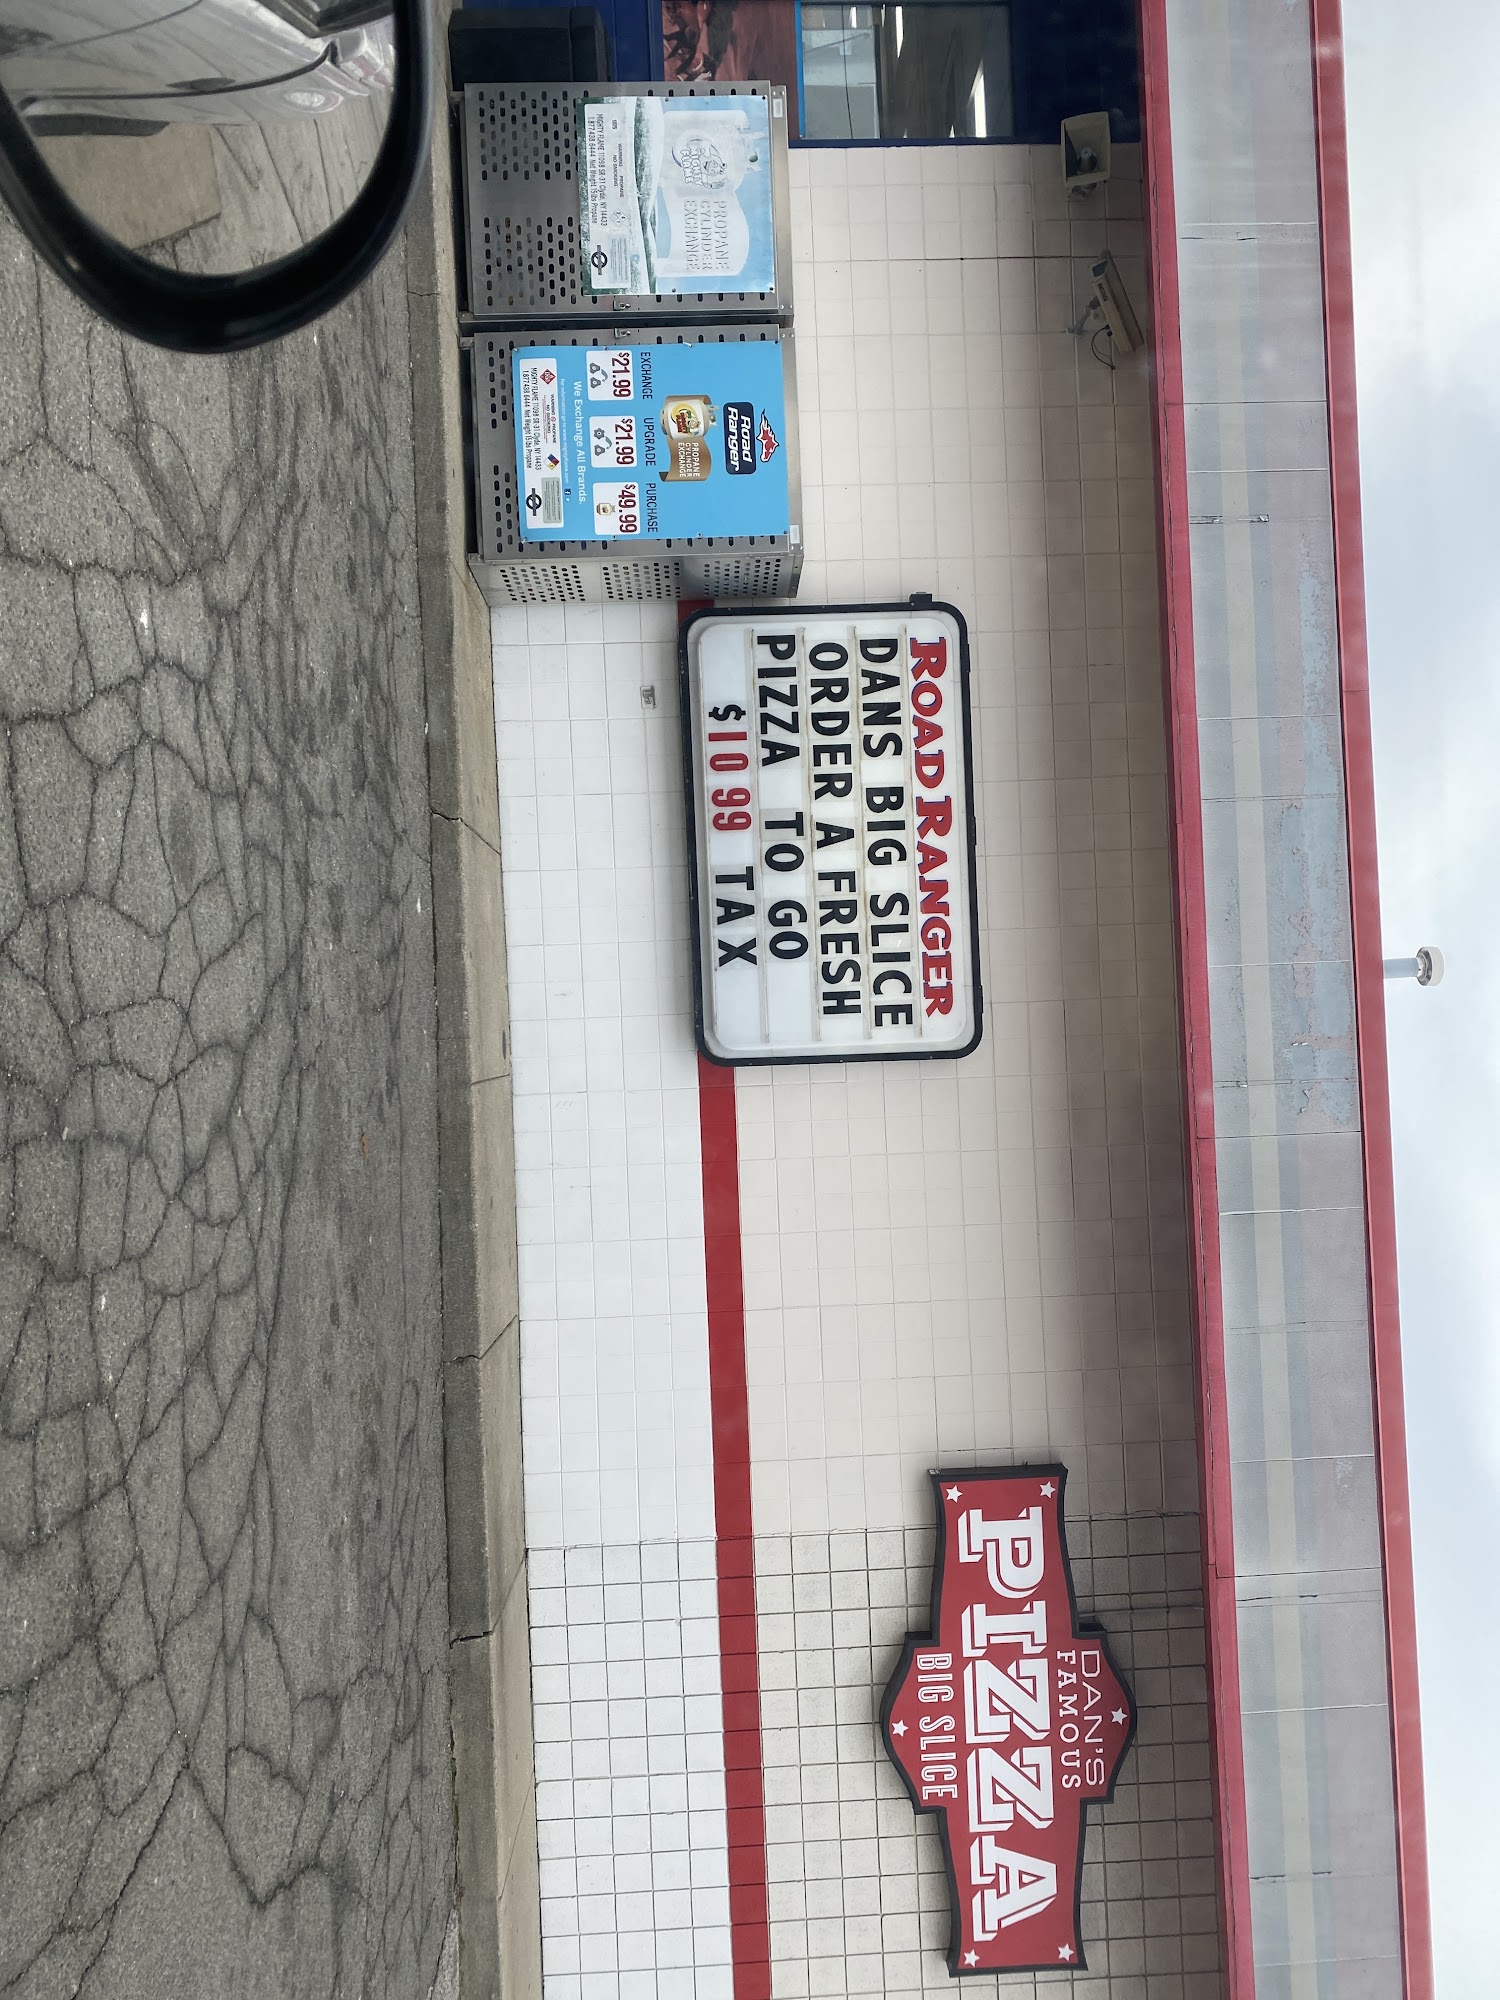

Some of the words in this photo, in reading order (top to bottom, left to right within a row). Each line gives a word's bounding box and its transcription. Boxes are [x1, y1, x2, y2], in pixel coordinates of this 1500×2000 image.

[597, 135, 605, 151] FLAME
[680, 149, 694, 184] FLAME
[690, 147, 703, 186] MIGHTY
[600, 210, 608, 226] 14433
[684, 200, 700, 270] EXCHANGE
[700, 200, 713, 270] CYLINDER
[713, 200, 730, 270] PROPANE
[531, 386, 539, 401] FLAME
[573, 381, 582, 396] We
[611, 352, 631, 398] $21.99
[640, 352, 653, 400] EXCHANGE
[573, 399, 583, 447] Exchange
[614, 418, 634, 465] $21.99
[643, 417, 656, 466] UPGRADE
[727, 406, 740, 471] Ranger
[740, 415, 753, 463] Road
[525, 449, 533, 469] Propane
[534, 455, 542, 471] 14433
[576, 449, 585, 463] All
[678, 442, 686, 477] EXCHANGE
[691, 442, 700, 477] PROPANE
[577, 465, 587, 505] Brands.
[618, 484, 638, 533] $49.99
[645, 482, 658, 533] PURCHASE
[757, 634, 800, 767] PIZZA
[808, 642, 853, 800] ORDER
[860, 638, 903, 758] DANS
[910, 636, 947, 789] ROAD
[764, 812, 805, 872] TO
[815, 822, 855, 849] A
[866, 786, 907, 866] BIG
[715, 866, 758, 967] TAX
[767, 901, 808, 960] GO
[916, 796, 954, 1018] RANGER
[817, 871, 862, 1015] FRESH
[870, 894, 913, 1027] SLICE
[916, 1652, 954, 1703] BIG
[957, 1506, 1058, 1942] PIZZA
[1056, 1650, 1081, 1790] FAMOUS
[1080, 1650, 1105, 1786] DAN'S
[919, 1716, 958, 1800] SLICE
